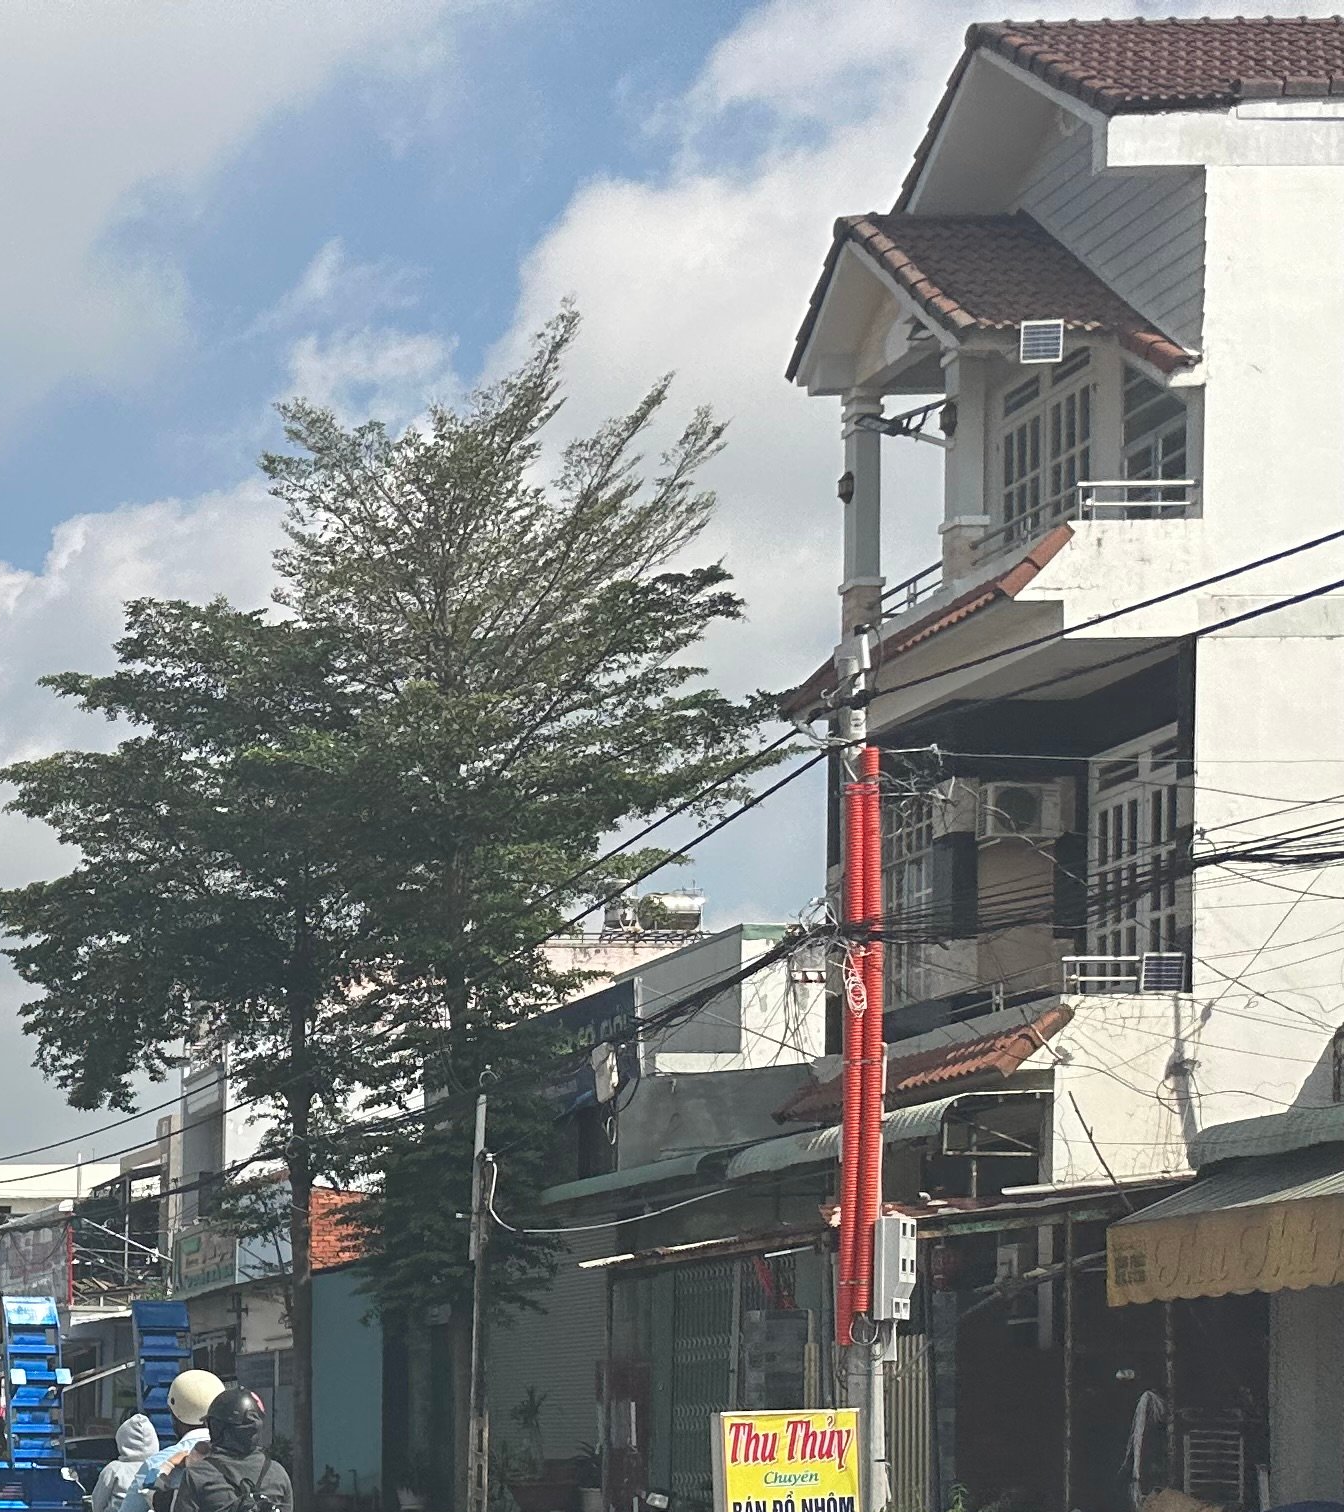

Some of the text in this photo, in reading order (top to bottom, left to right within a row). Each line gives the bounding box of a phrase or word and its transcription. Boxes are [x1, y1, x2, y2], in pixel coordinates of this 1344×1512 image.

[729, 1415, 851, 1470] Thu Thủy
[764, 1470, 820, 1486] Chuyên
